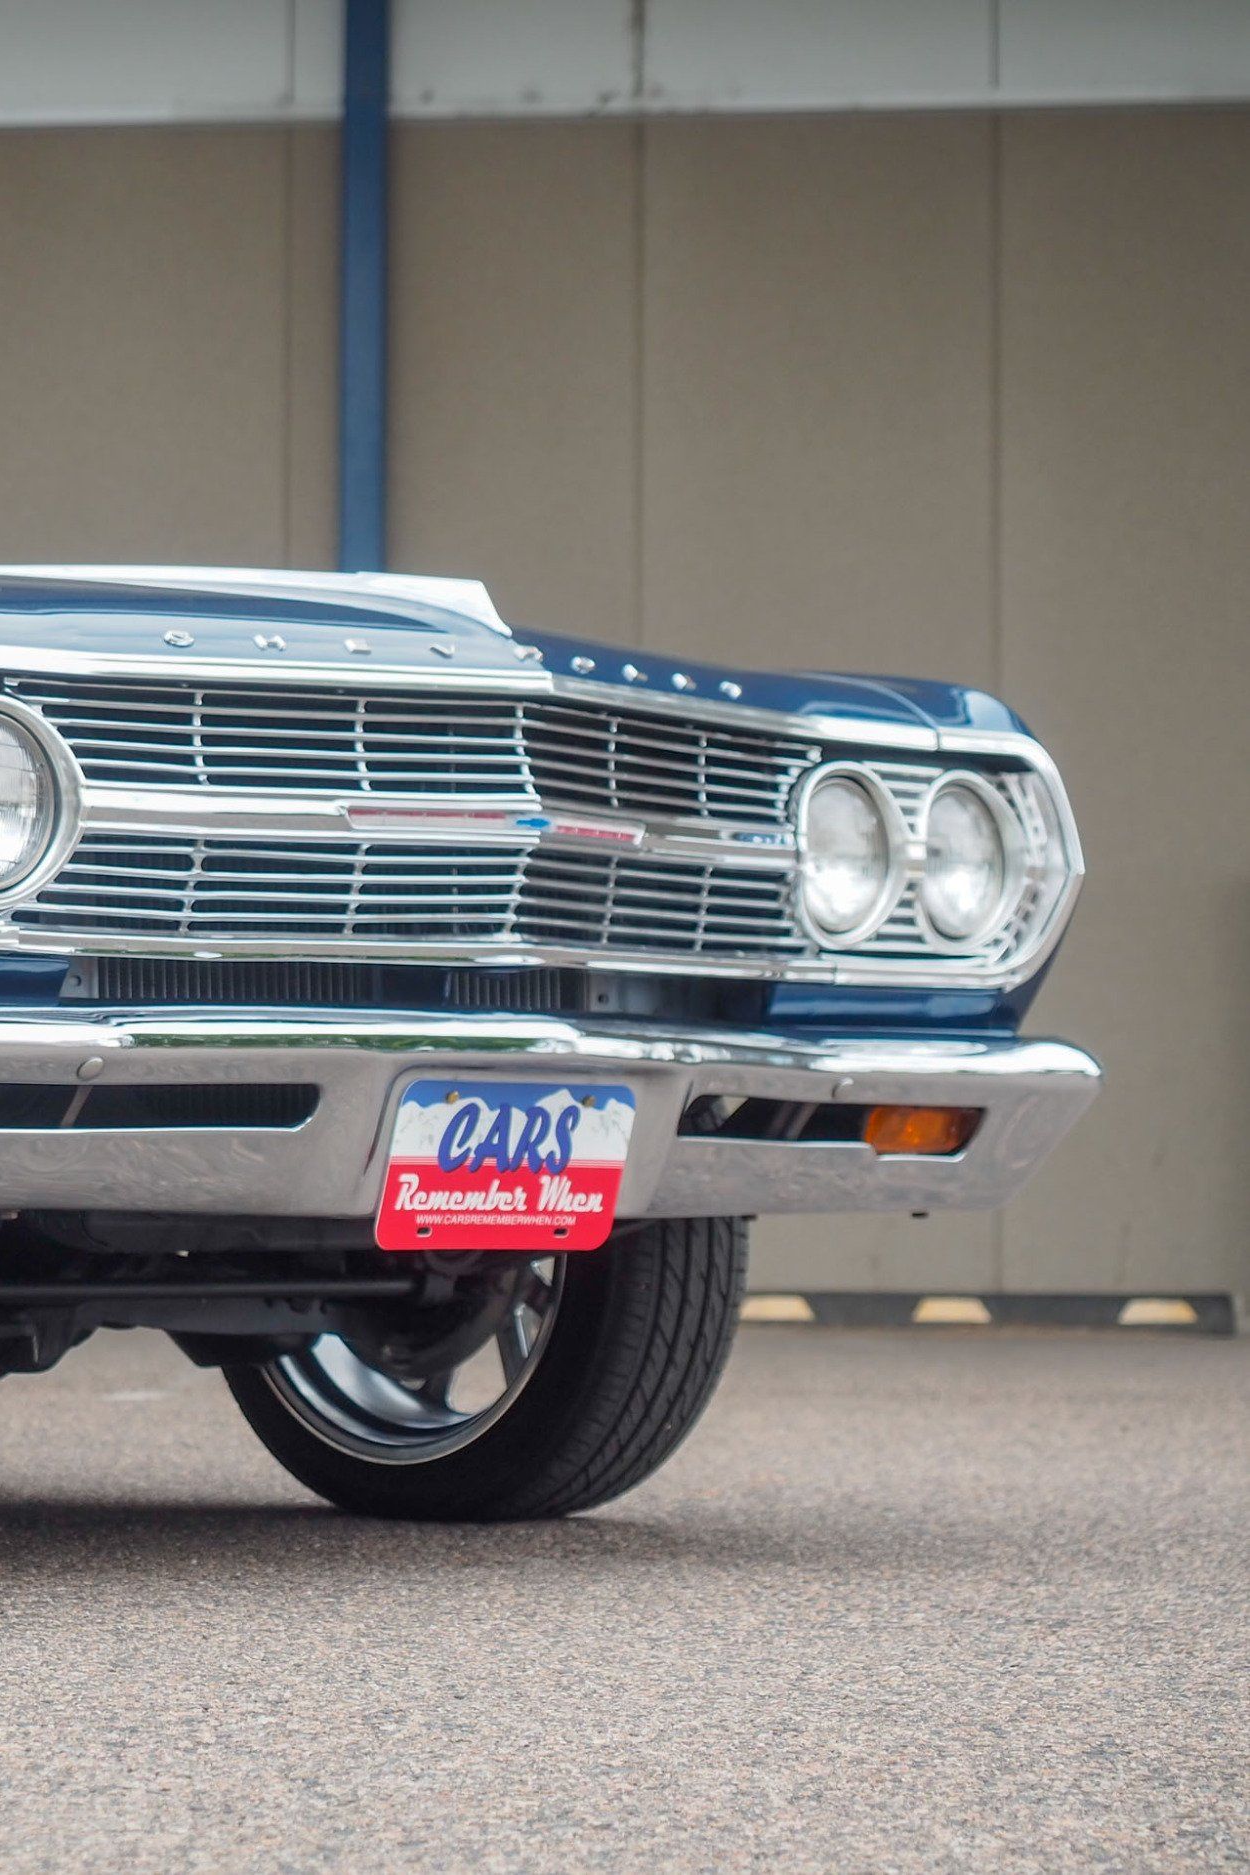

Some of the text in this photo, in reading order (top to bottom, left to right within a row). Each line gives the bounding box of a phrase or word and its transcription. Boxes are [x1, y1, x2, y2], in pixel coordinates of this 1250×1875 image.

[437, 1102, 581, 1174] CARS
[394, 1173, 604, 1213] Remember When
[415, 1214, 576, 1226] WWW.CARSREMEMBERWHEN.COM
